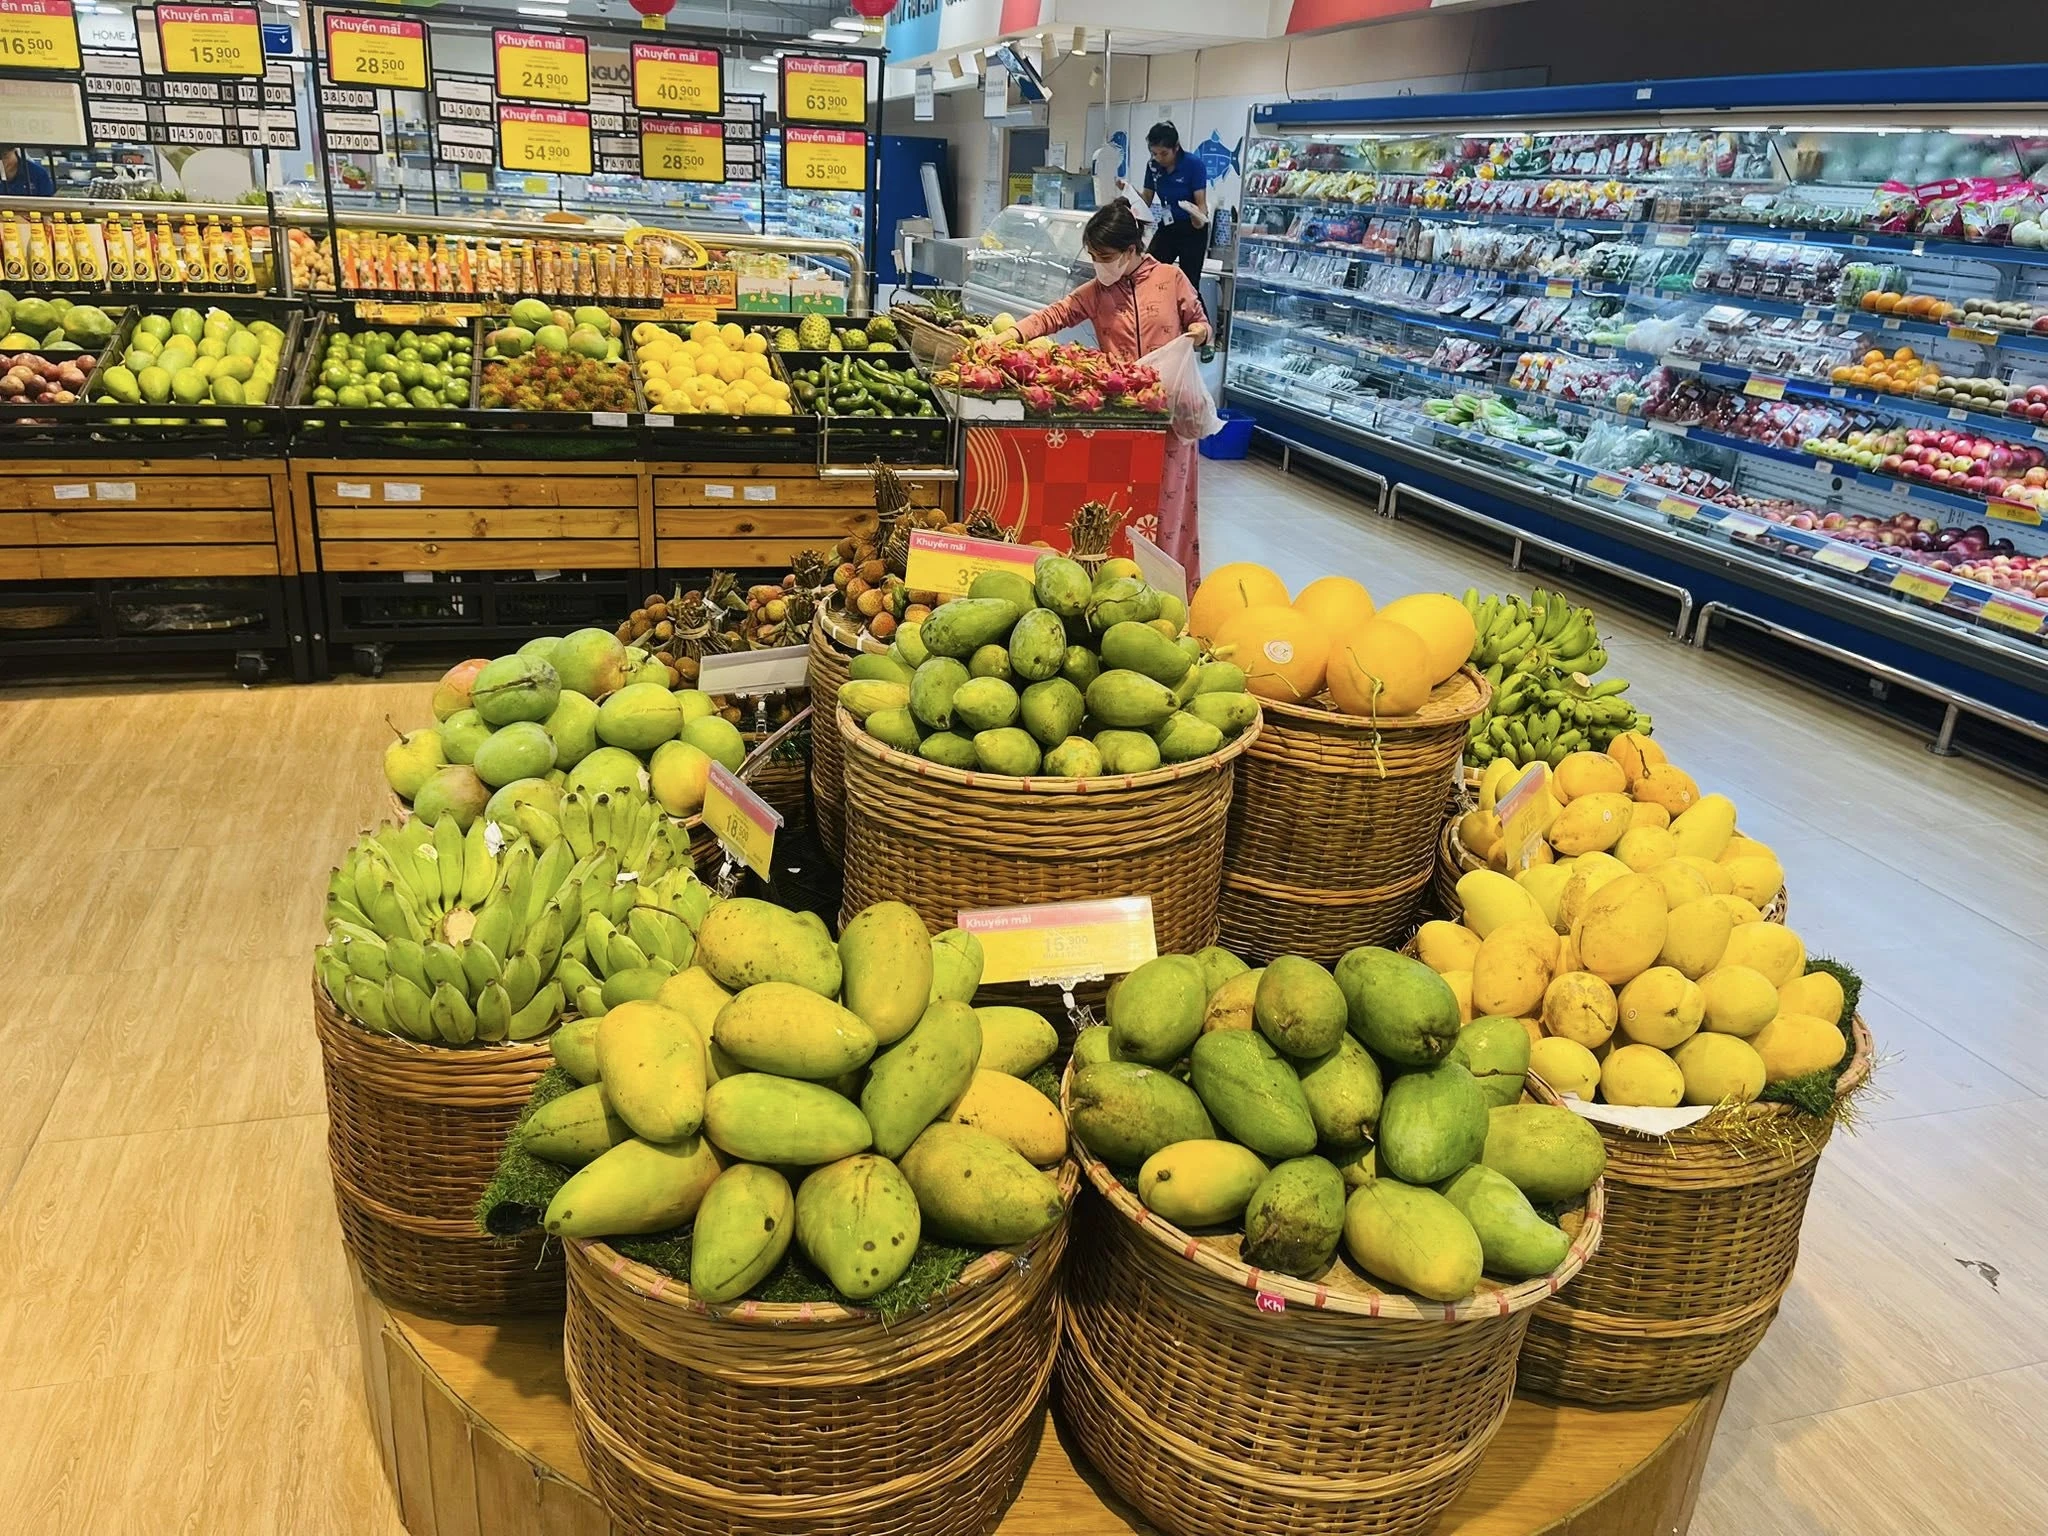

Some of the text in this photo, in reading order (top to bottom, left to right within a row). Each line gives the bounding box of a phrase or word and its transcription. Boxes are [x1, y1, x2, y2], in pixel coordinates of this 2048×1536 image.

[21, 1, 46, 13] mãi
[161, 8, 234, 23] Khuyến mãi
[331, 18, 401, 35] Khuyến mãi
[92, 30, 126, 41] HOME
[499, 33, 566, 50] Khuyến mãi
[189, 46, 240, 63] 15.900
[635, 47, 698, 63] Khuyến mãi
[355, 56, 405, 74] 28.500
[787, 60, 827, 74] Khuyến
[522, 71, 568, 88] 24.900
[657, 84, 701, 101] 40.900
[806, 94, 848, 111] 63.900
[500, 107, 567, 124] Khuyến mãi
[642, 121, 702, 136] Khuyến mãi
[786, 130, 845, 143] Khuyến mãi
[524, 145, 570, 161] 54.900
[662, 154, 704, 170] 28.500
[806, 164, 847, 180] 35.900
[916, 537, 967, 552] Khuyến mãi
[966, 914, 1032, 930] Khuyến mãi
